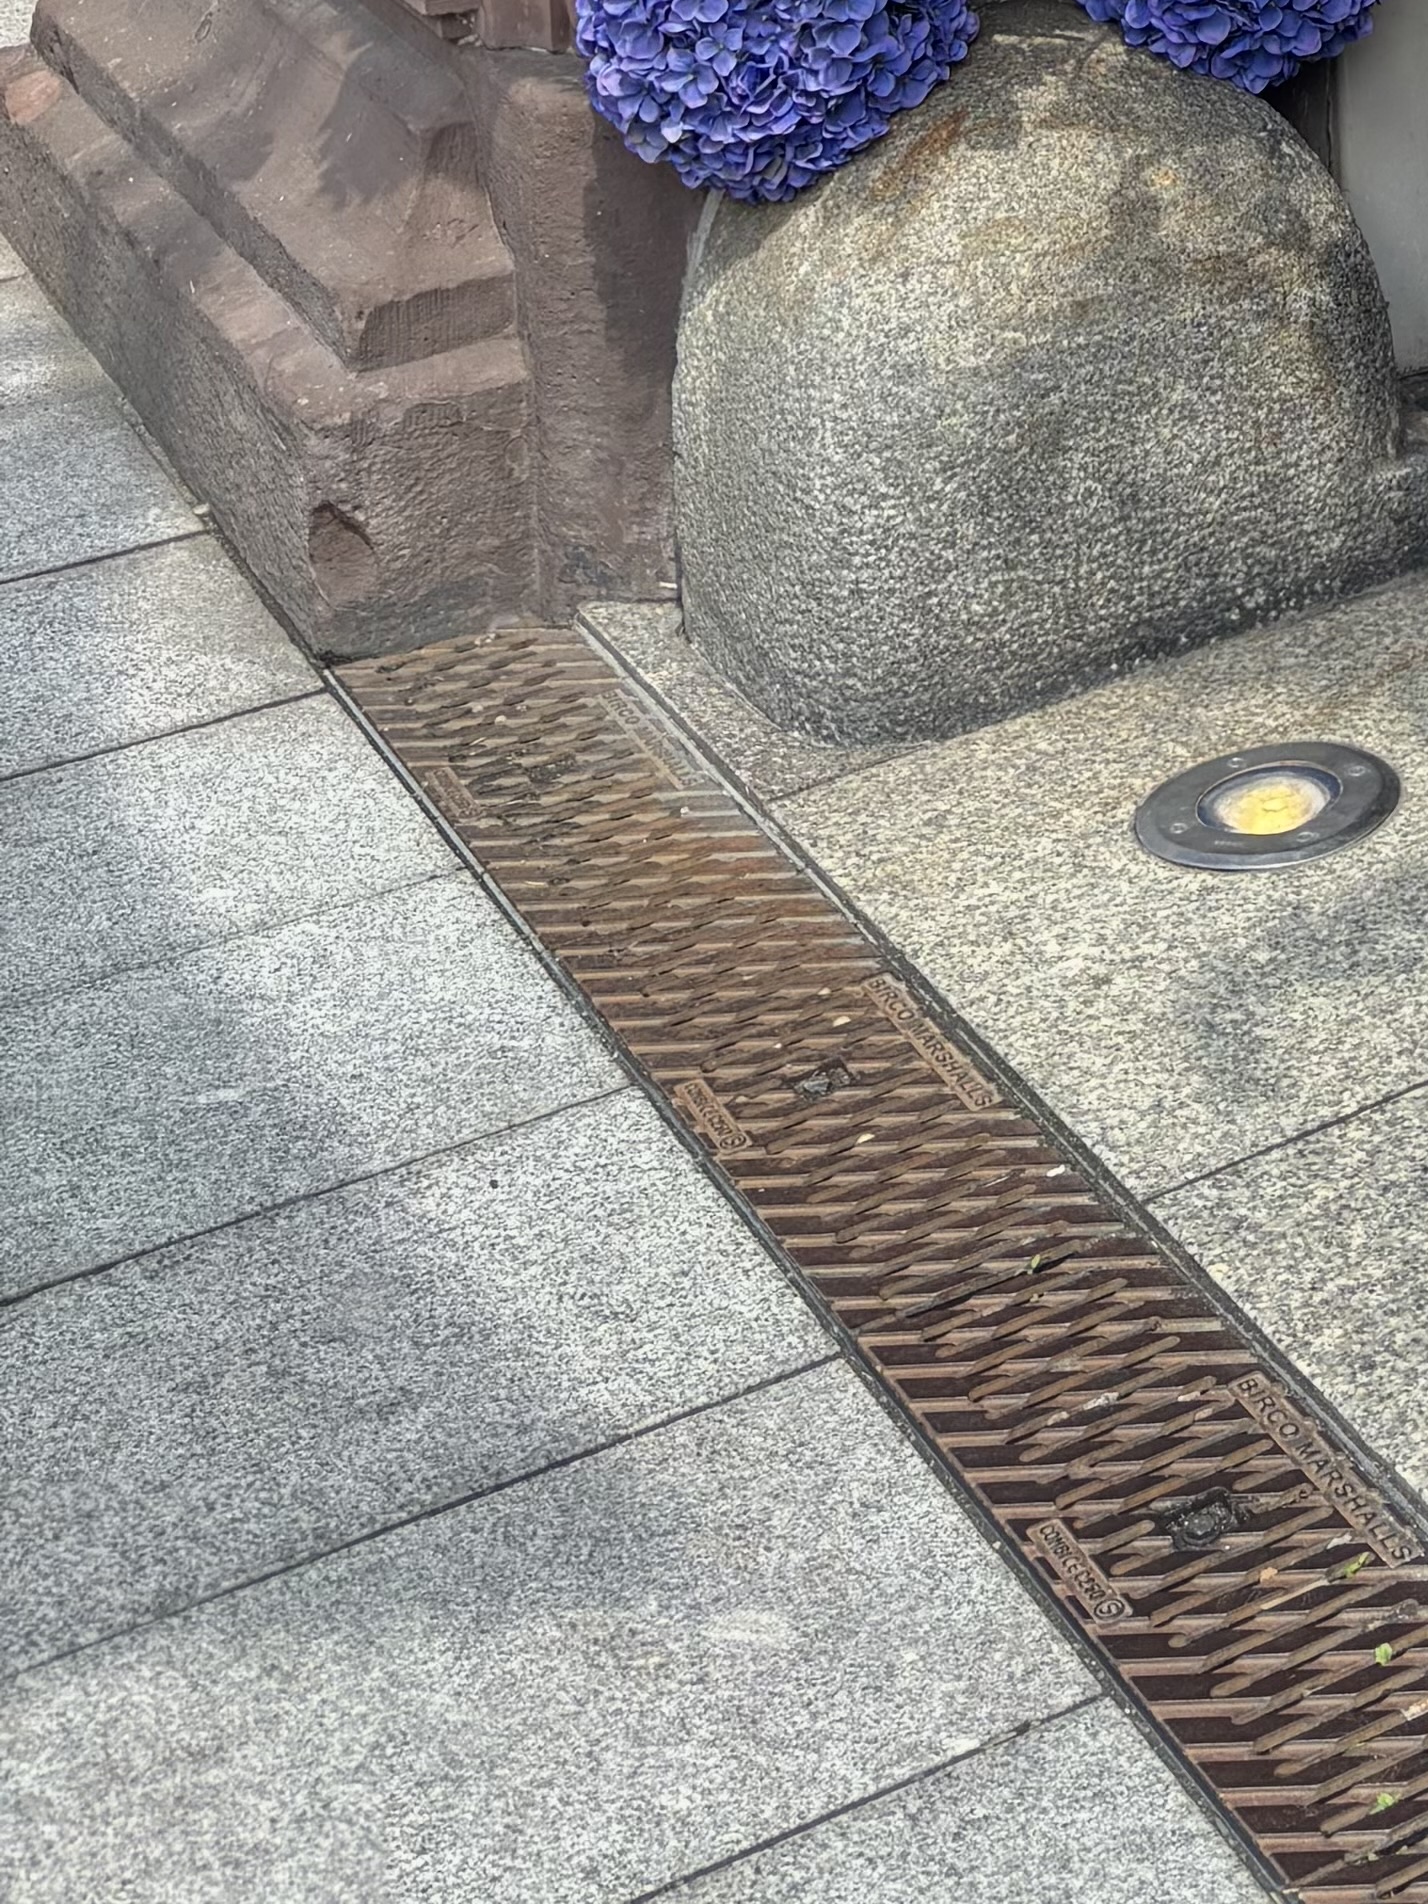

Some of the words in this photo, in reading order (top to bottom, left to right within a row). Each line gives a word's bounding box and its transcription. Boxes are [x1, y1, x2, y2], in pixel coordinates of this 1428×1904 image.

[869, 978, 915, 1020] BIRCO
[910, 1019, 993, 1108] MARSHALLS
[1239, 1378, 1300, 1439] BIRCO
[1296, 1441, 1412, 1561] MARSHALLS
